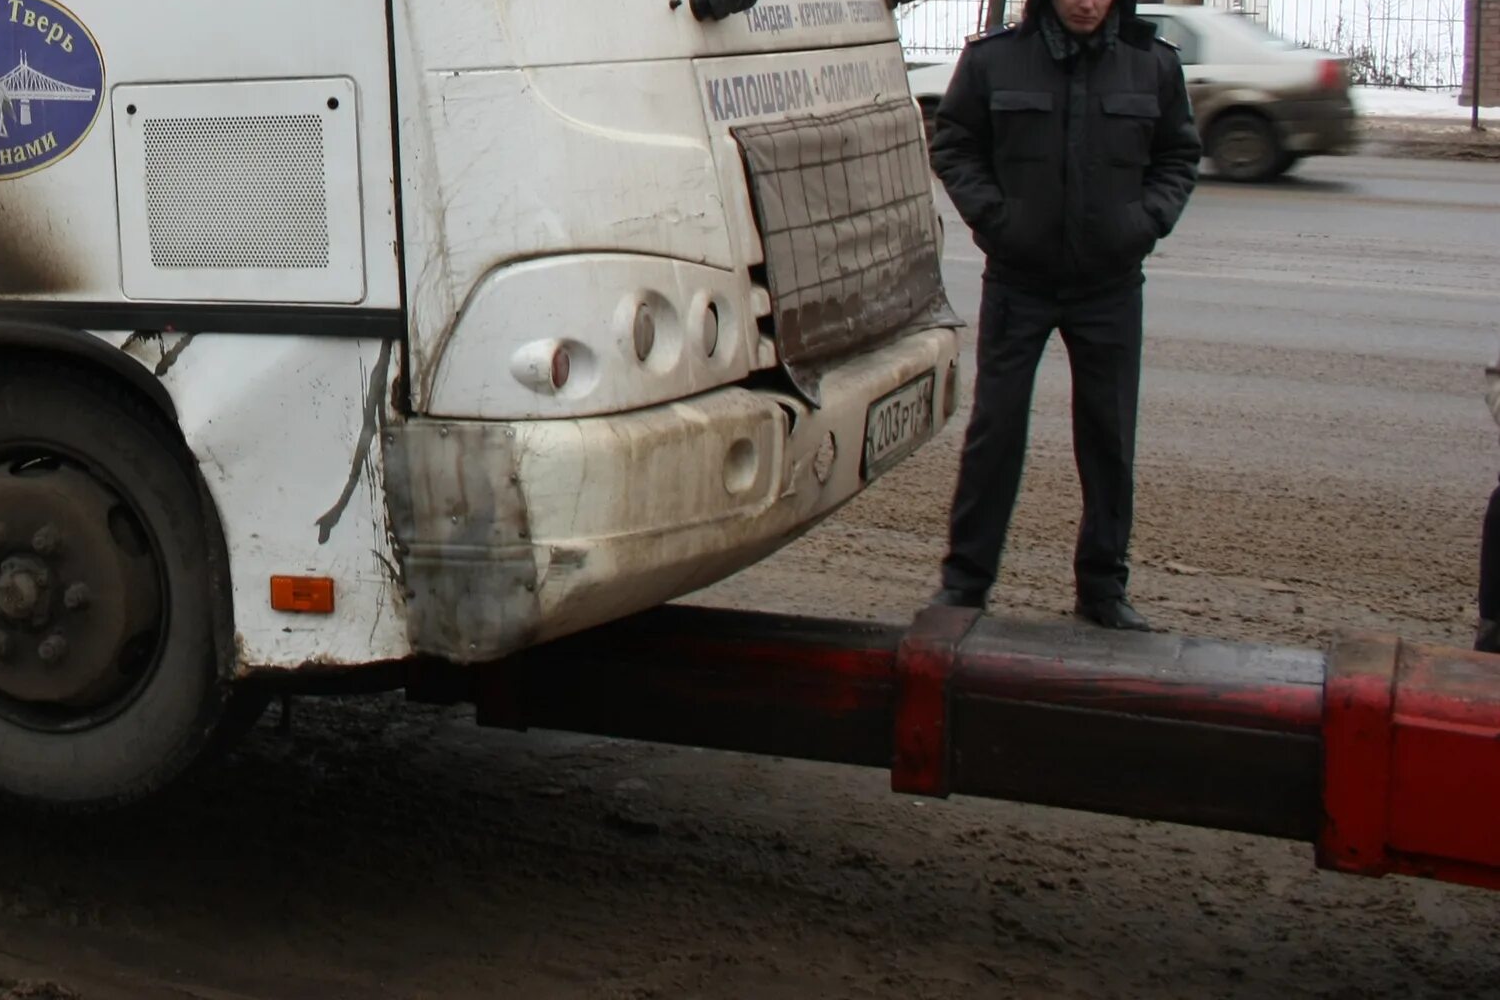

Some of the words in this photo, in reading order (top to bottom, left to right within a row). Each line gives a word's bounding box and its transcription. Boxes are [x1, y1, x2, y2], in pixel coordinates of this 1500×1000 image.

[743, 4, 794, 35] ТАНДЕМ
[707, 69, 814, 121] КАПОШВАРА
[820, 60, 874, 104] СПАРТАКА
[0, 131, 58, 166] нами
